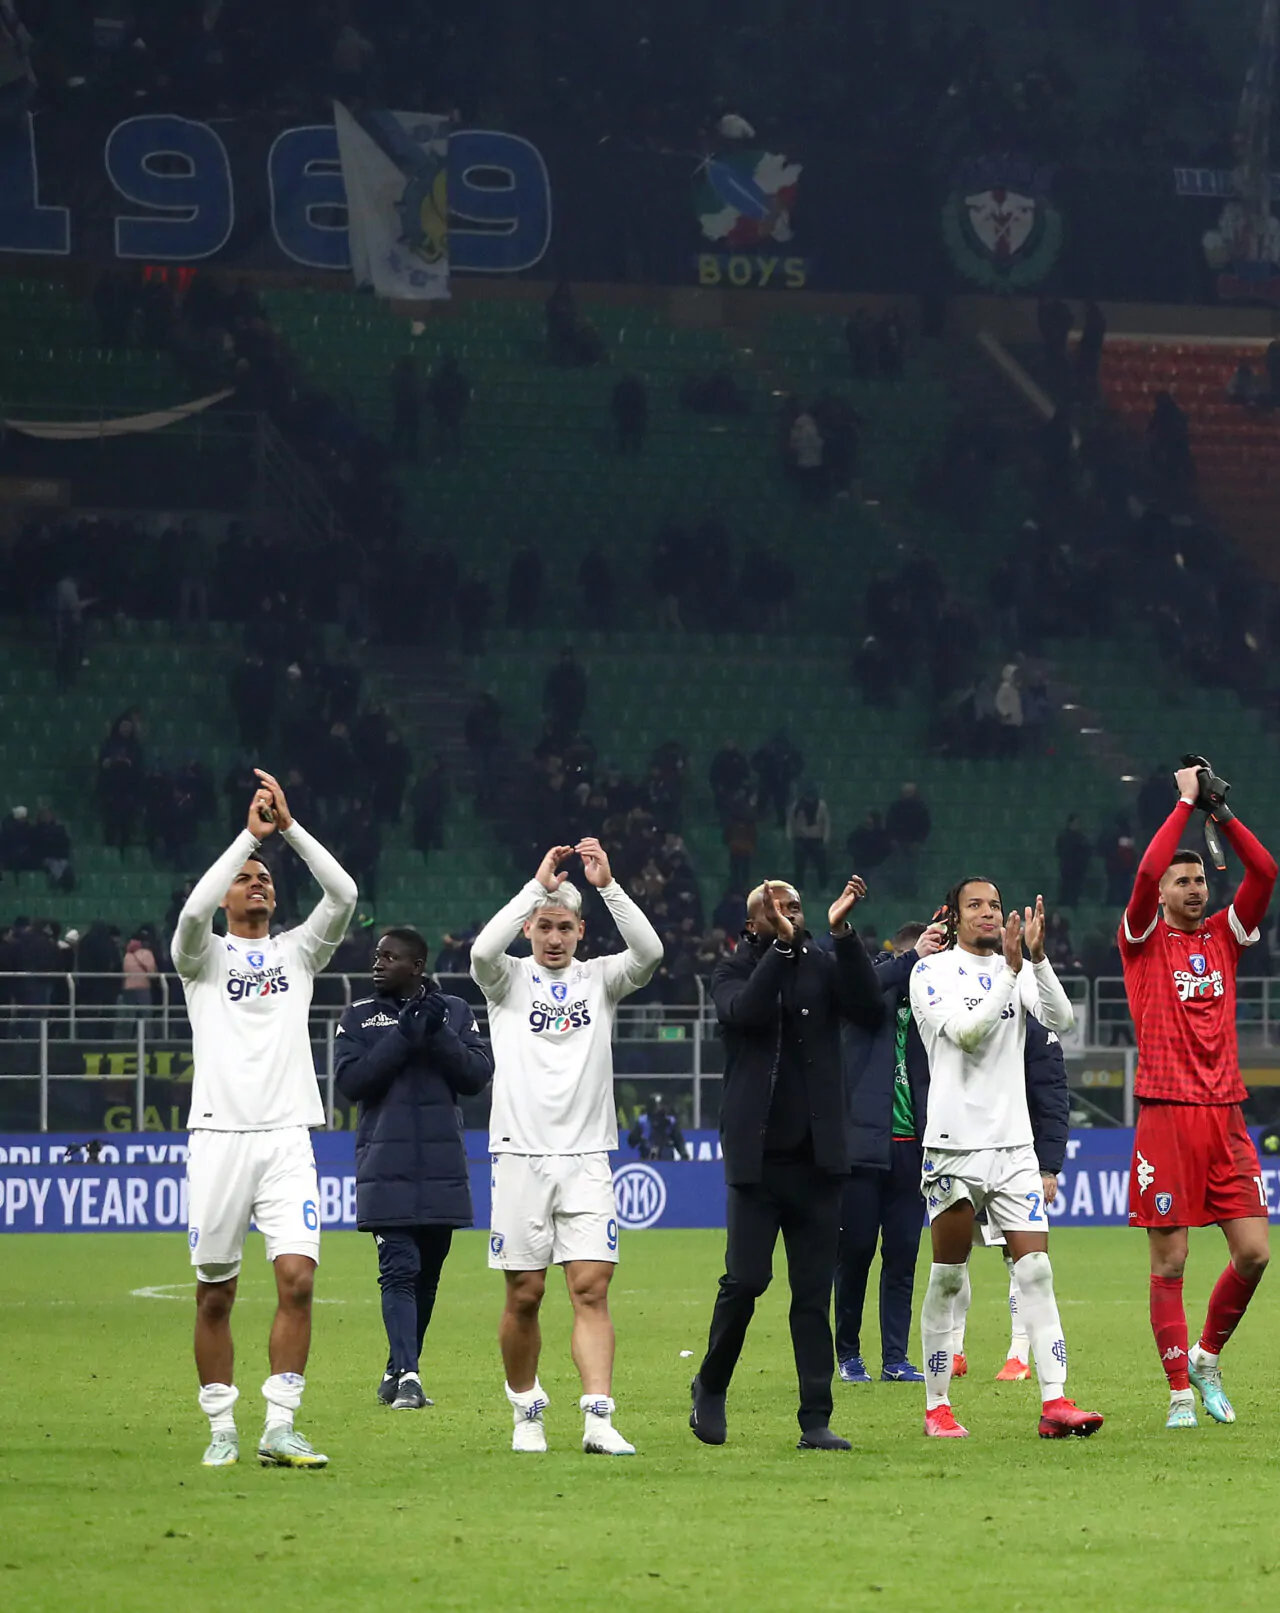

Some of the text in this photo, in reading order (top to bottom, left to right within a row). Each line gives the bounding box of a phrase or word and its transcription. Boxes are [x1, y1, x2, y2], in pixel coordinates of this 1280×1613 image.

[697, 253, 808, 289] BOYS
[226, 975, 290, 1002] gross
[528, 1008, 592, 1034] gross
[57, 1178, 149, 1226] YEAR
